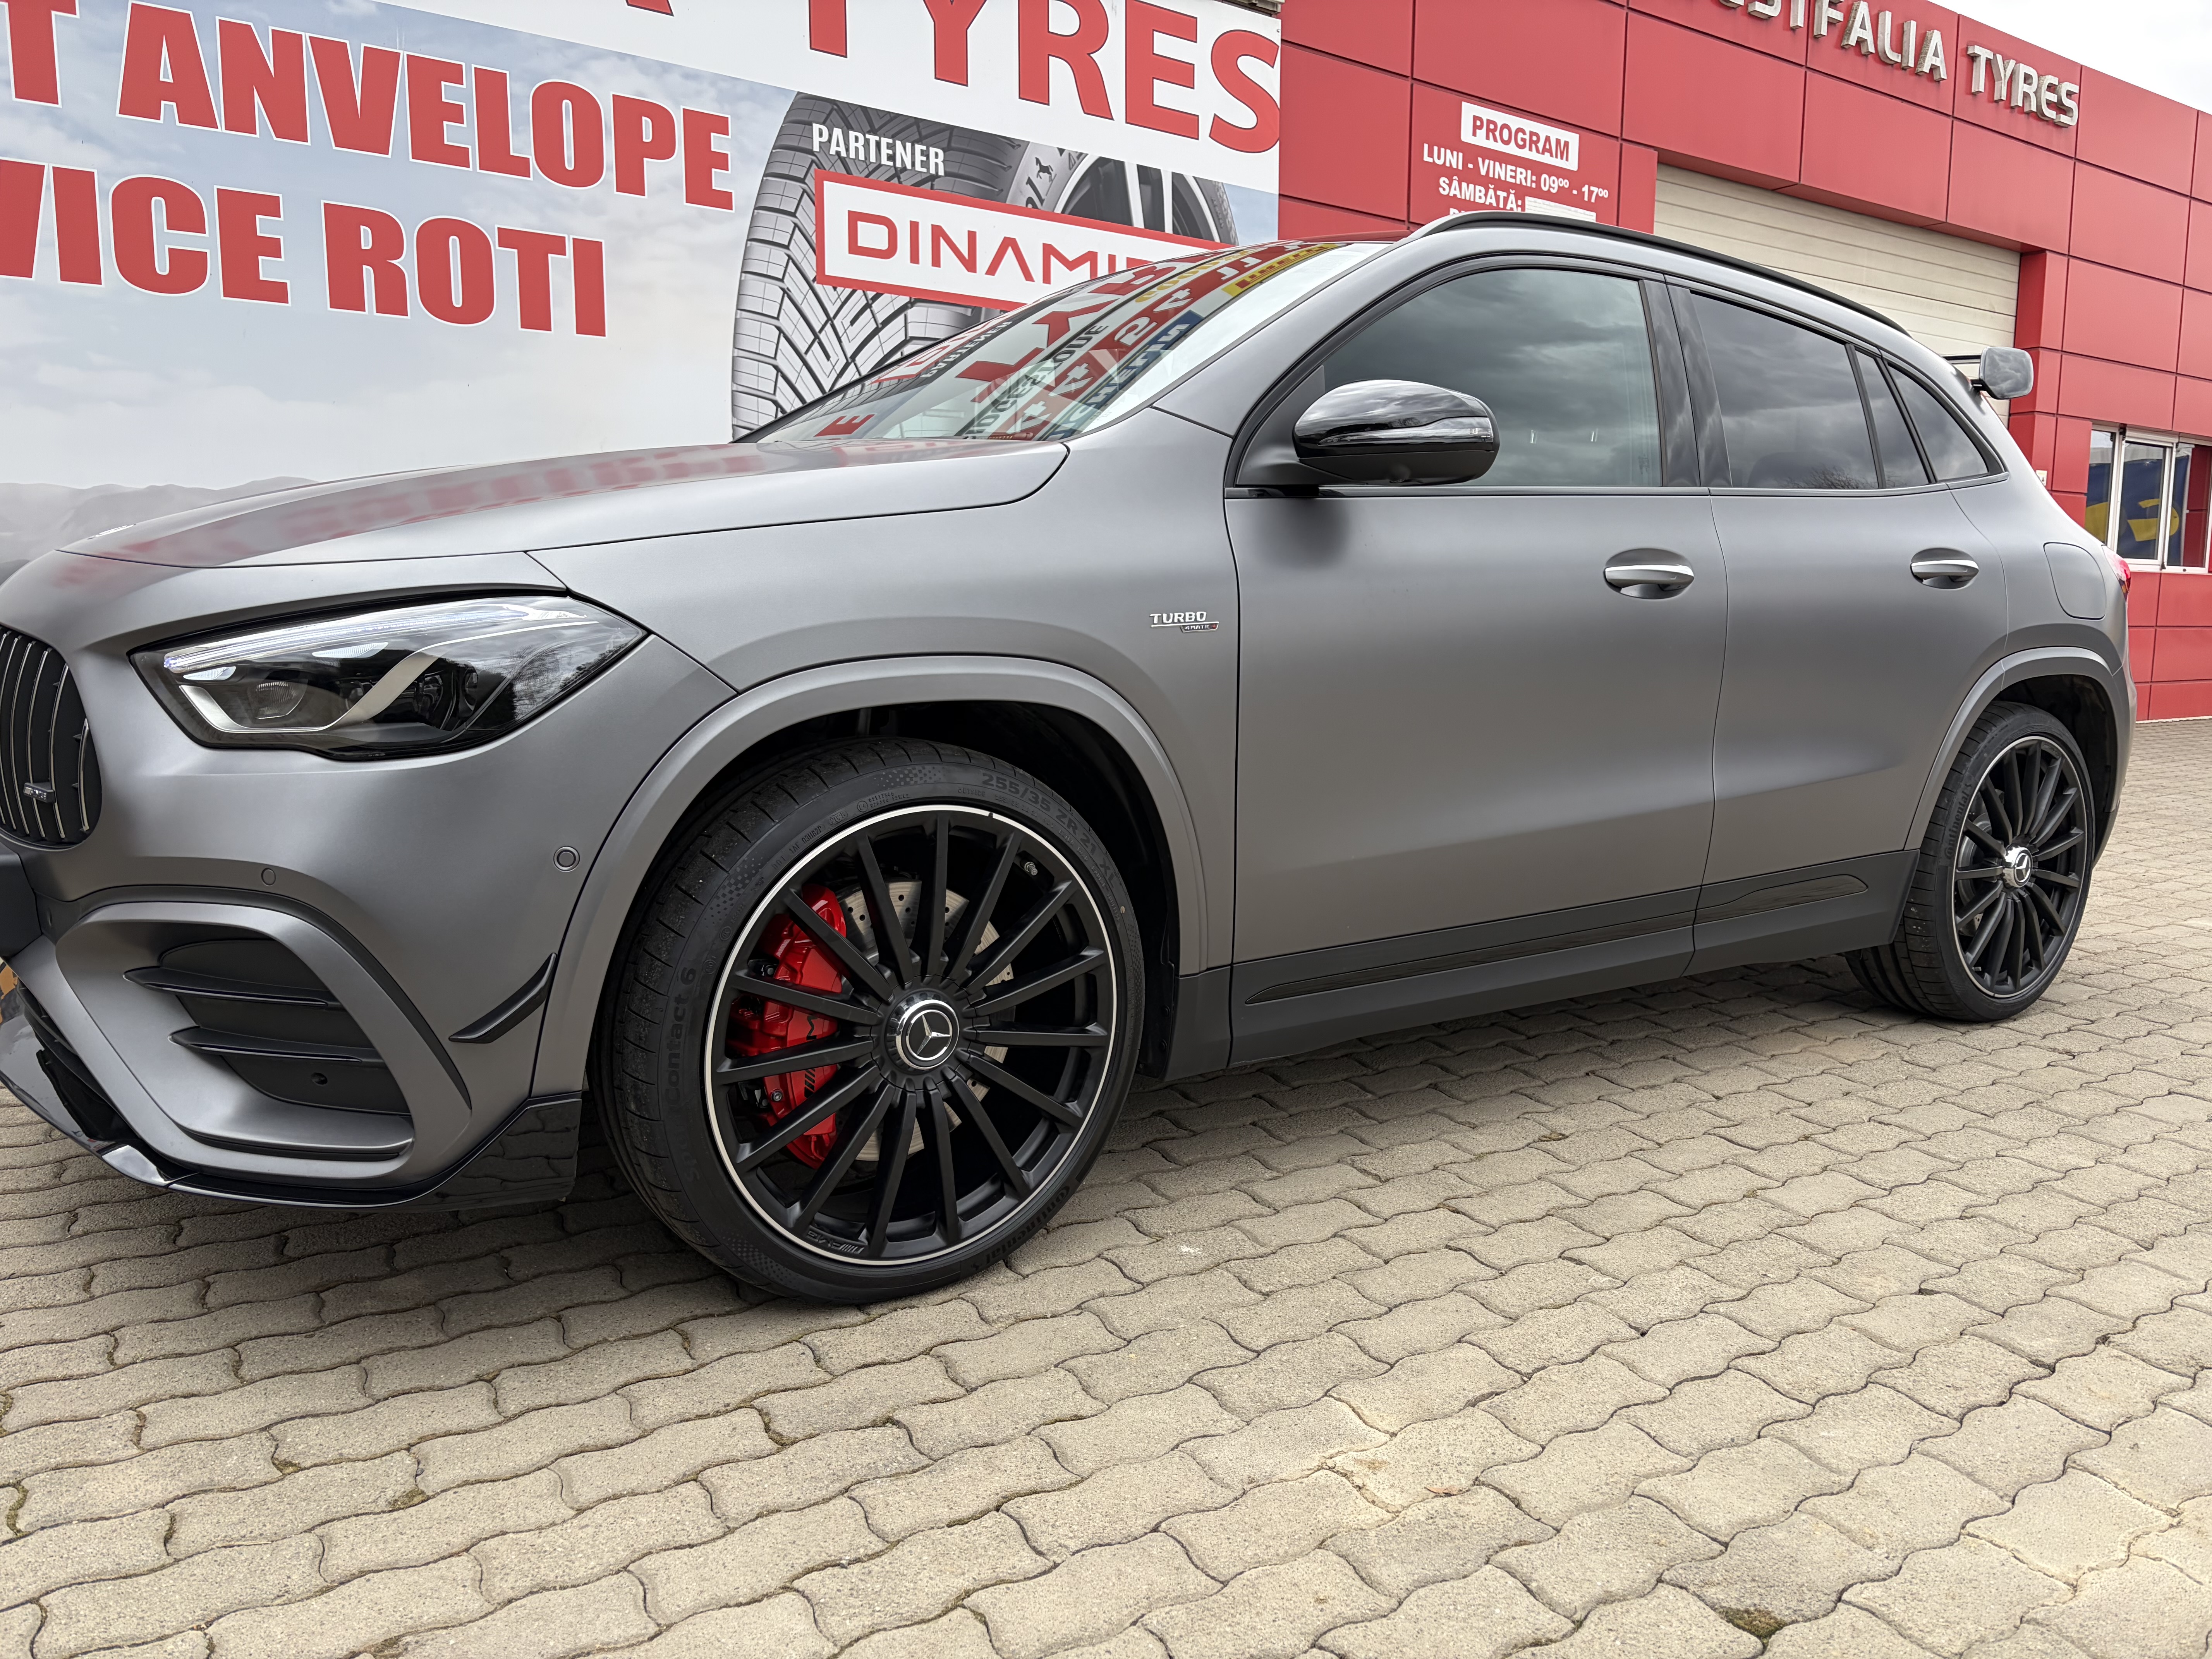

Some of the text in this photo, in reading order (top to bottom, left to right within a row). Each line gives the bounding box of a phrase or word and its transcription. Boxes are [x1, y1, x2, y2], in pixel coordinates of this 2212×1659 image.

[1719, 0, 2079, 127] FALIA TYRES
[117, 1, 735, 212] ANVELOPE
[812, 122, 945, 177] PARTENER
[1423, 143, 1463, 170] LUNI
[1478, 157, 1536, 188] VINERI:
[1472, 115, 1570, 162] PROGRAM
[321, 200, 607, 338] ROTI
[847, 210, 1156, 285] DINAM
[1150, 611, 1207, 624] TURBO
[982, 773, 1051, 812] 255/35
[1056, 808, 1078, 836] ZR
[1944, 790, 1970, 860] Continental
[680, 967, 696, 986] 6
